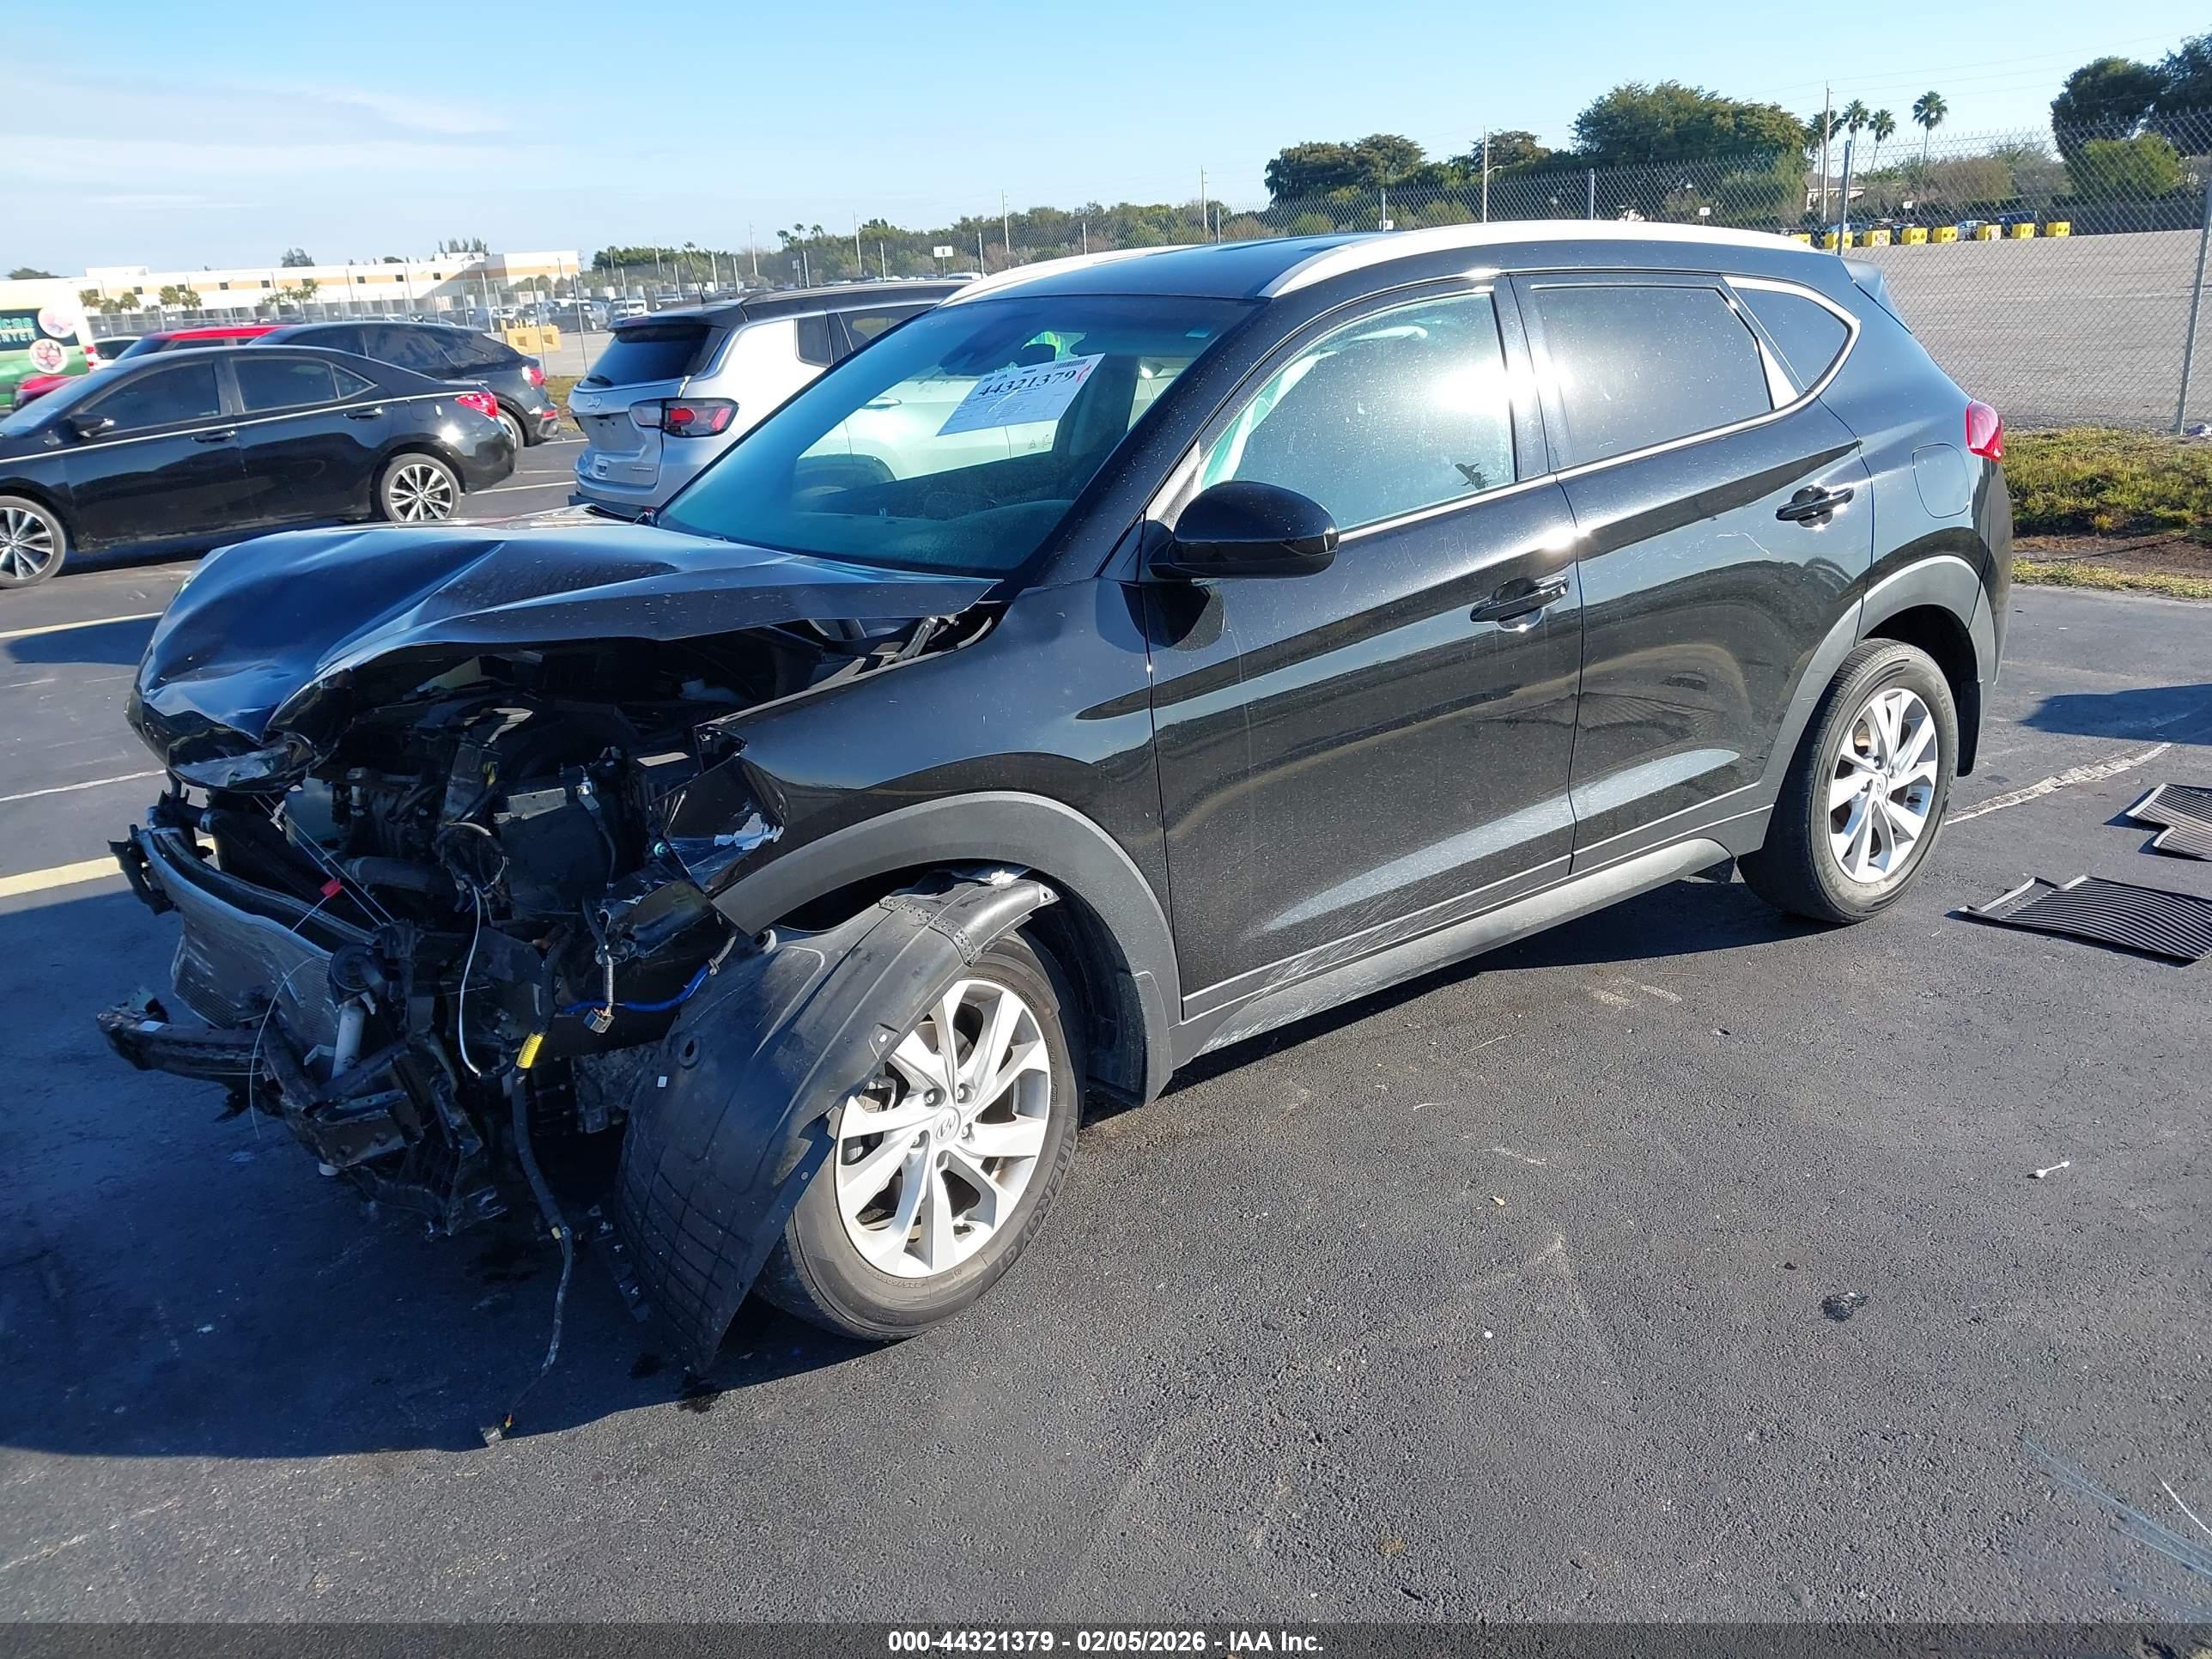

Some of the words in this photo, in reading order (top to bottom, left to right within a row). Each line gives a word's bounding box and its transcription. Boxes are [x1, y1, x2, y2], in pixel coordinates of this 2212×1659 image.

[0, 328, 36, 343] NTER
[978, 369, 1077, 397] 44321379
[995, 1244, 1018, 1279] GT
